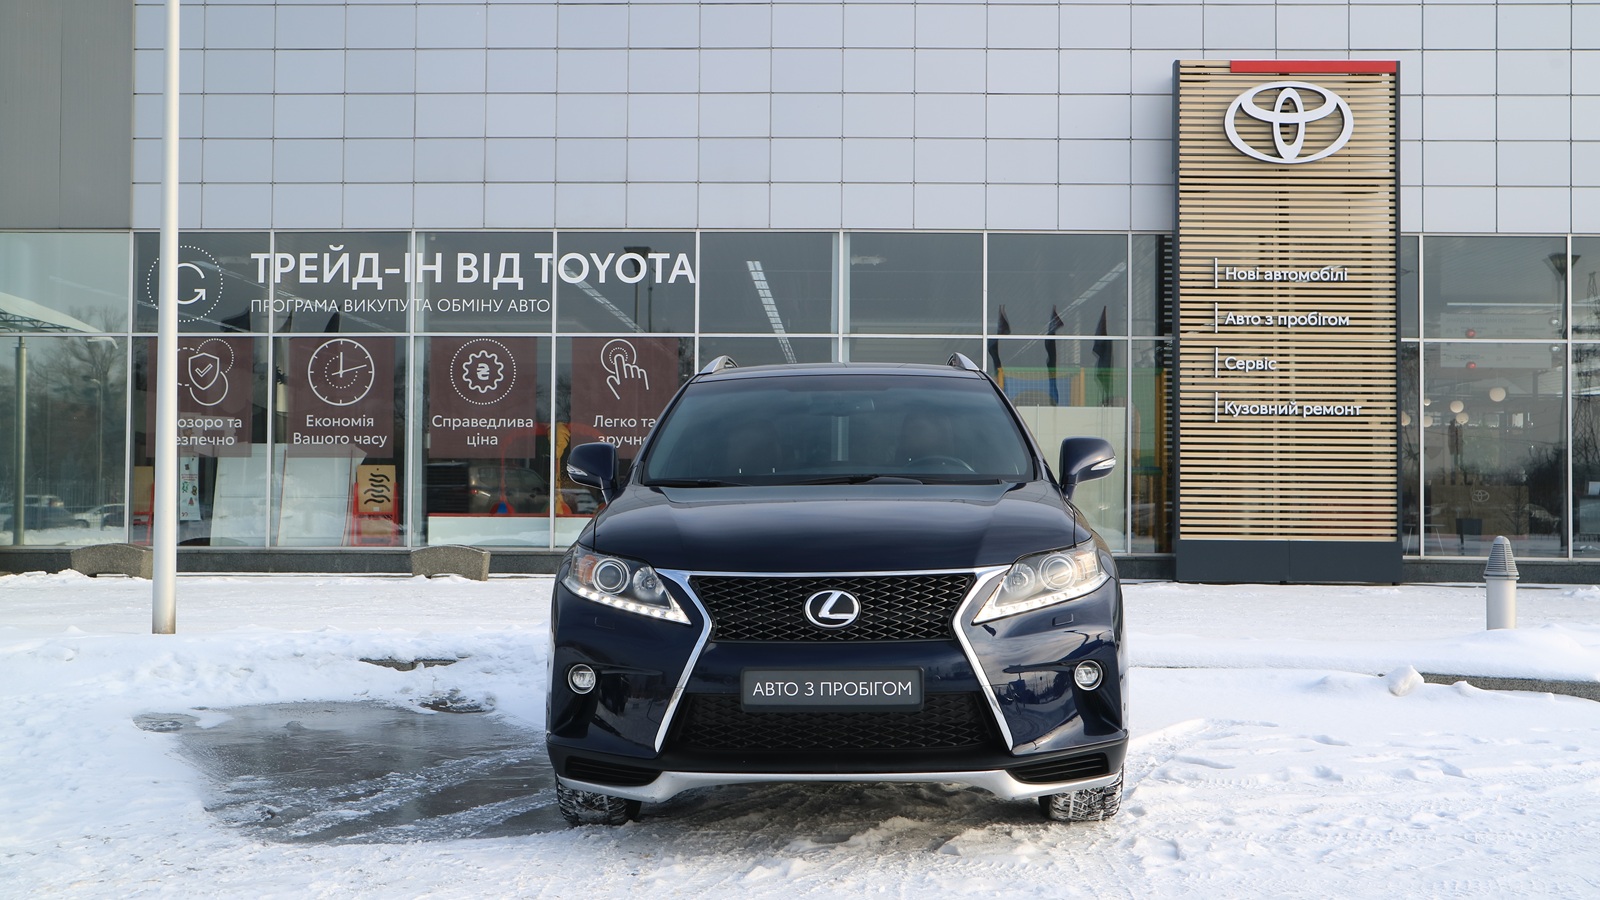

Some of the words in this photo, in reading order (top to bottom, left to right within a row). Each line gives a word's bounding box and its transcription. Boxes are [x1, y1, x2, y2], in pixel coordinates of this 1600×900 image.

[250, 244, 442, 290] ТРЕЙД-ІН
[456, 252, 524, 290] ВІД
[534, 252, 696, 284] TOYOTA
[1225, 267, 1260, 280] Нові
[1264, 267, 1348, 281] автомобілі
[251, 299, 339, 313] ПРОГРАМА
[344, 299, 410, 313] ВИКУПУ
[413, 298, 432, 312] ТА
[437, 298, 503, 313] ОБМІНУ
[507, 299, 550, 313] АВТО
[1225, 312, 1261, 326] Авто
[1264, 315, 1273, 326] з
[1277, 311, 1350, 328] пробігом
[1224, 356, 1277, 373] Сервіс
[1224, 401, 1299, 418] Кузовний
[1302, 405, 1362, 419] ремонт
[227, 419, 242, 428] та
[306, 414, 374, 427] Економія
[432, 415, 534, 430] Справедлива
[593, 415, 637, 428] Легко
[641, 418, 657, 428] та
[293, 432, 350, 445] Вашого
[353, 435, 387, 448] часу
[466, 432, 498, 447] ціна
[752, 682, 799, 696] АВТО
[804, 682, 815, 696] З
[820, 681, 913, 696] ПРОБІГОМ
